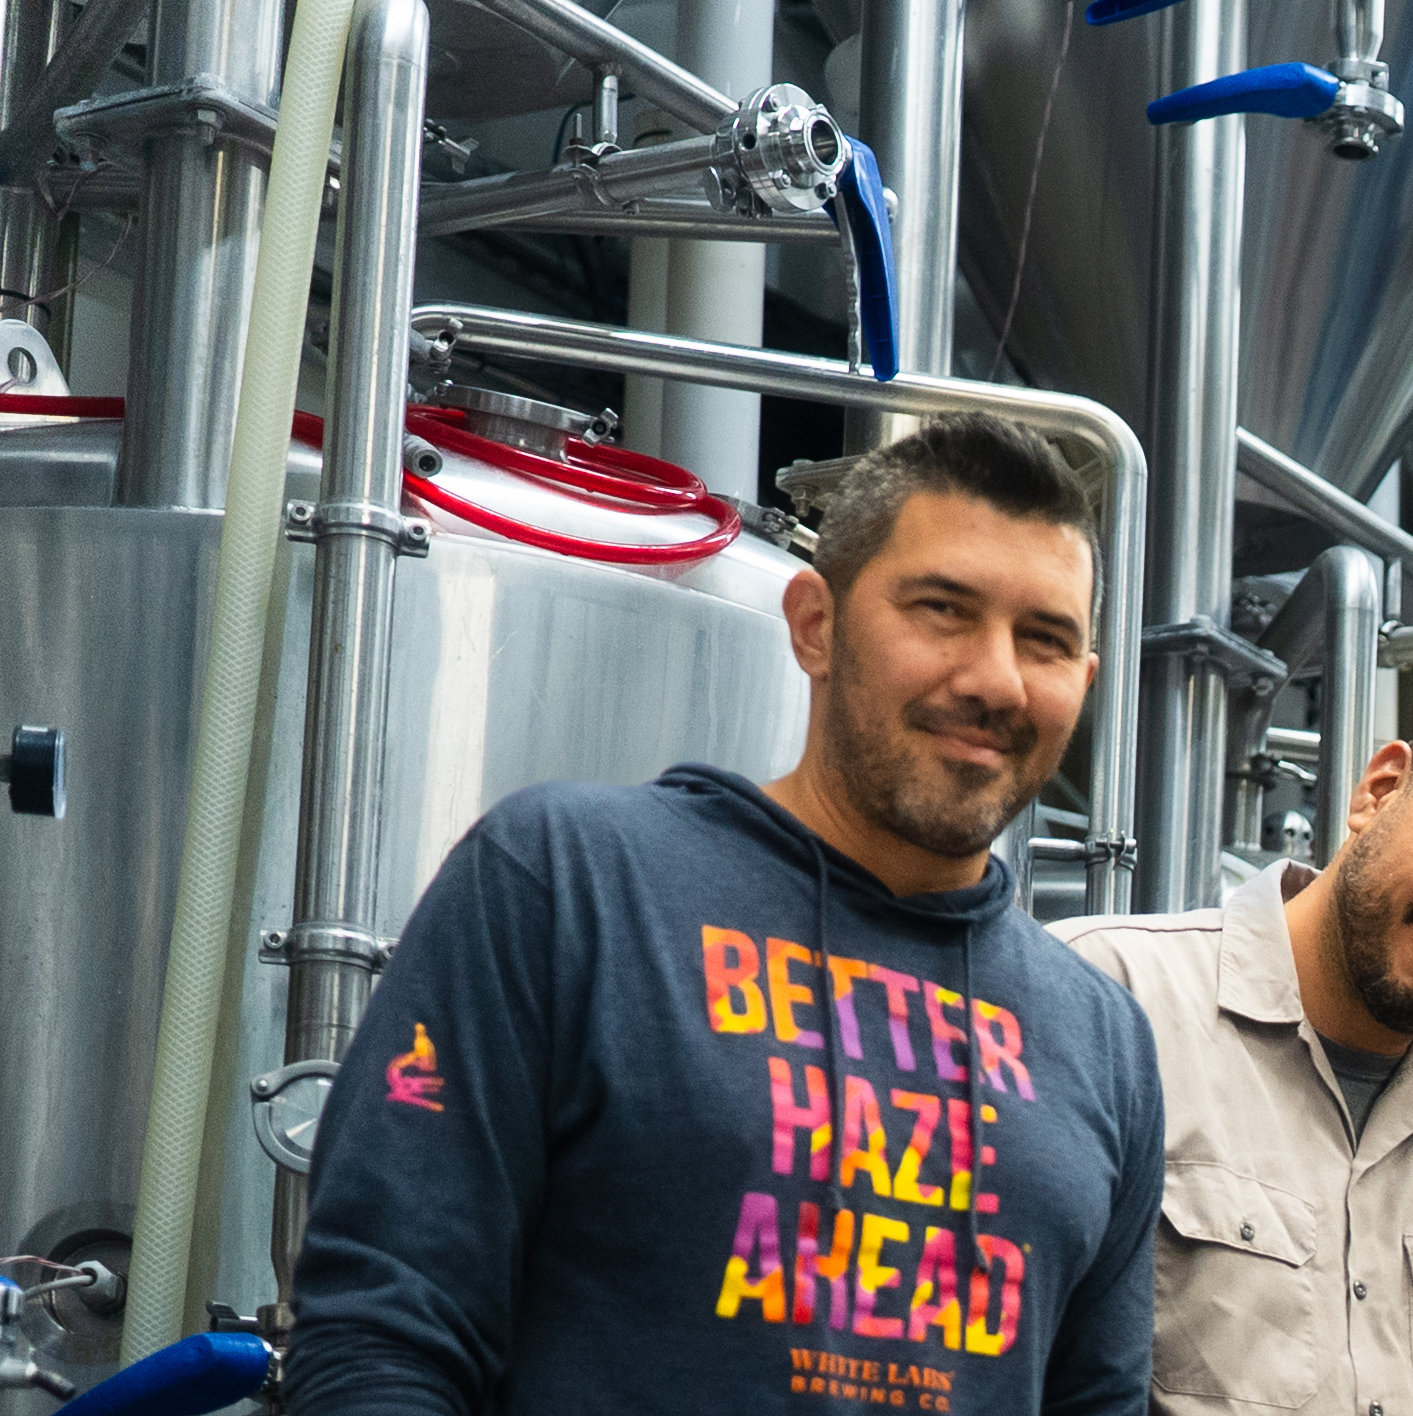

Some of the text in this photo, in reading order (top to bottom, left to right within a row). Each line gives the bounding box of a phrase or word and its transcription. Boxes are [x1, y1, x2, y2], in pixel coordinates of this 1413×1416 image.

[702, 924, 1036, 1101] BETTER
[768, 1056, 1000, 1214] HAZE
[715, 1191, 1026, 1356] AHEAD
[790, 1347, 881, 1383] WHITE
[790, 1374, 906, 1407] BREWING
